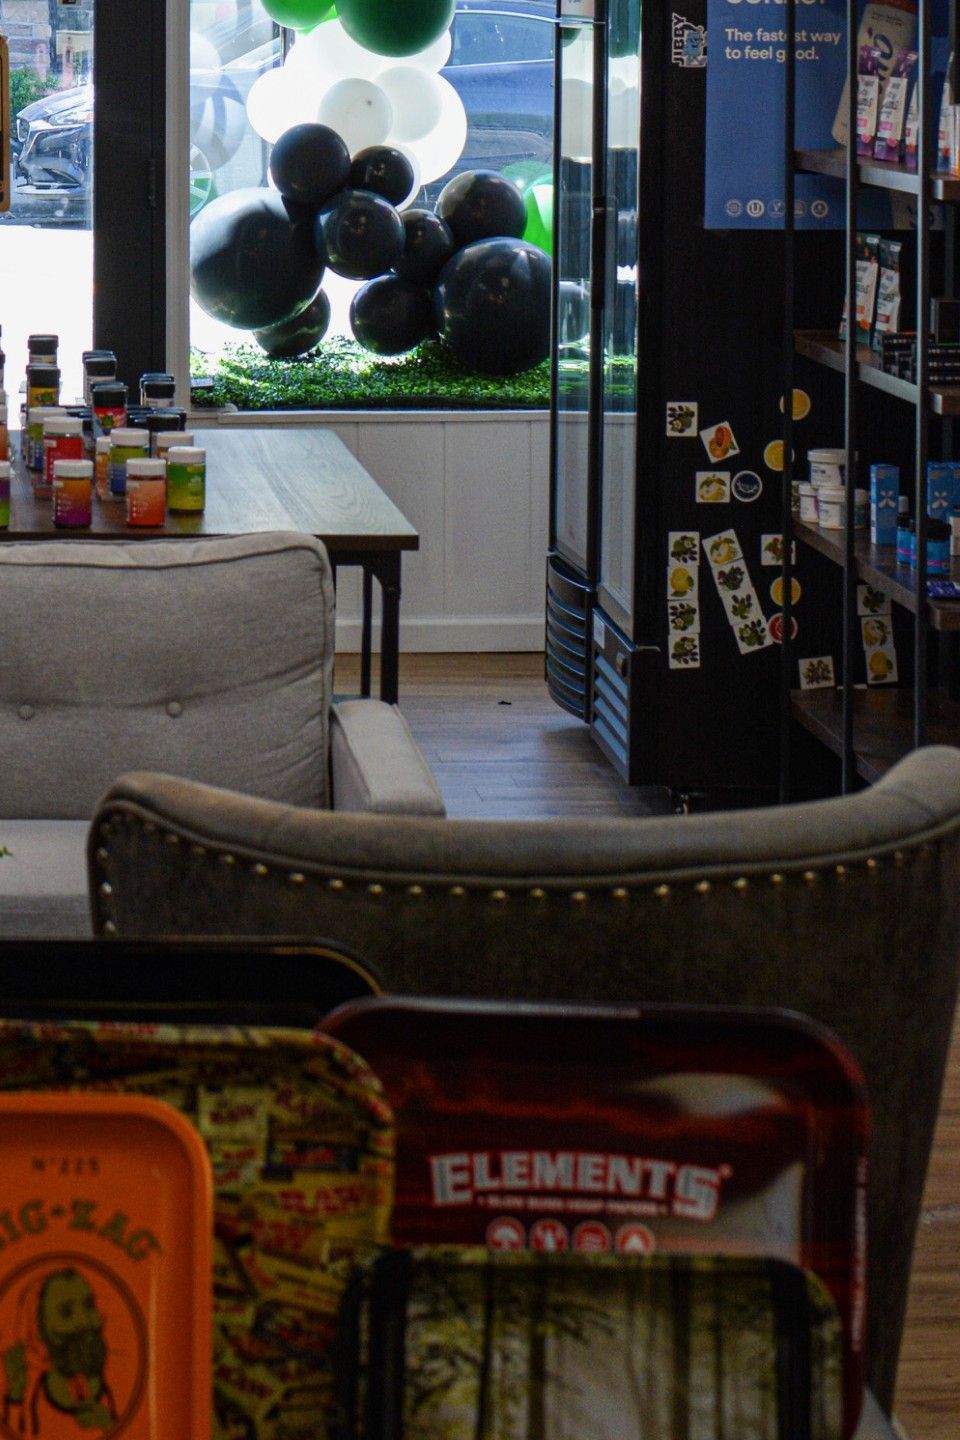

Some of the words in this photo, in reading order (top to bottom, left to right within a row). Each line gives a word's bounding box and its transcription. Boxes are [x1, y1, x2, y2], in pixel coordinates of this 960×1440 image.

[725, 28, 753, 42] The
[811, 32, 841, 46] way
[725, 47, 742, 60] to
[744, 46, 773, 60] feel
[776, 46, 819, 63] god.
